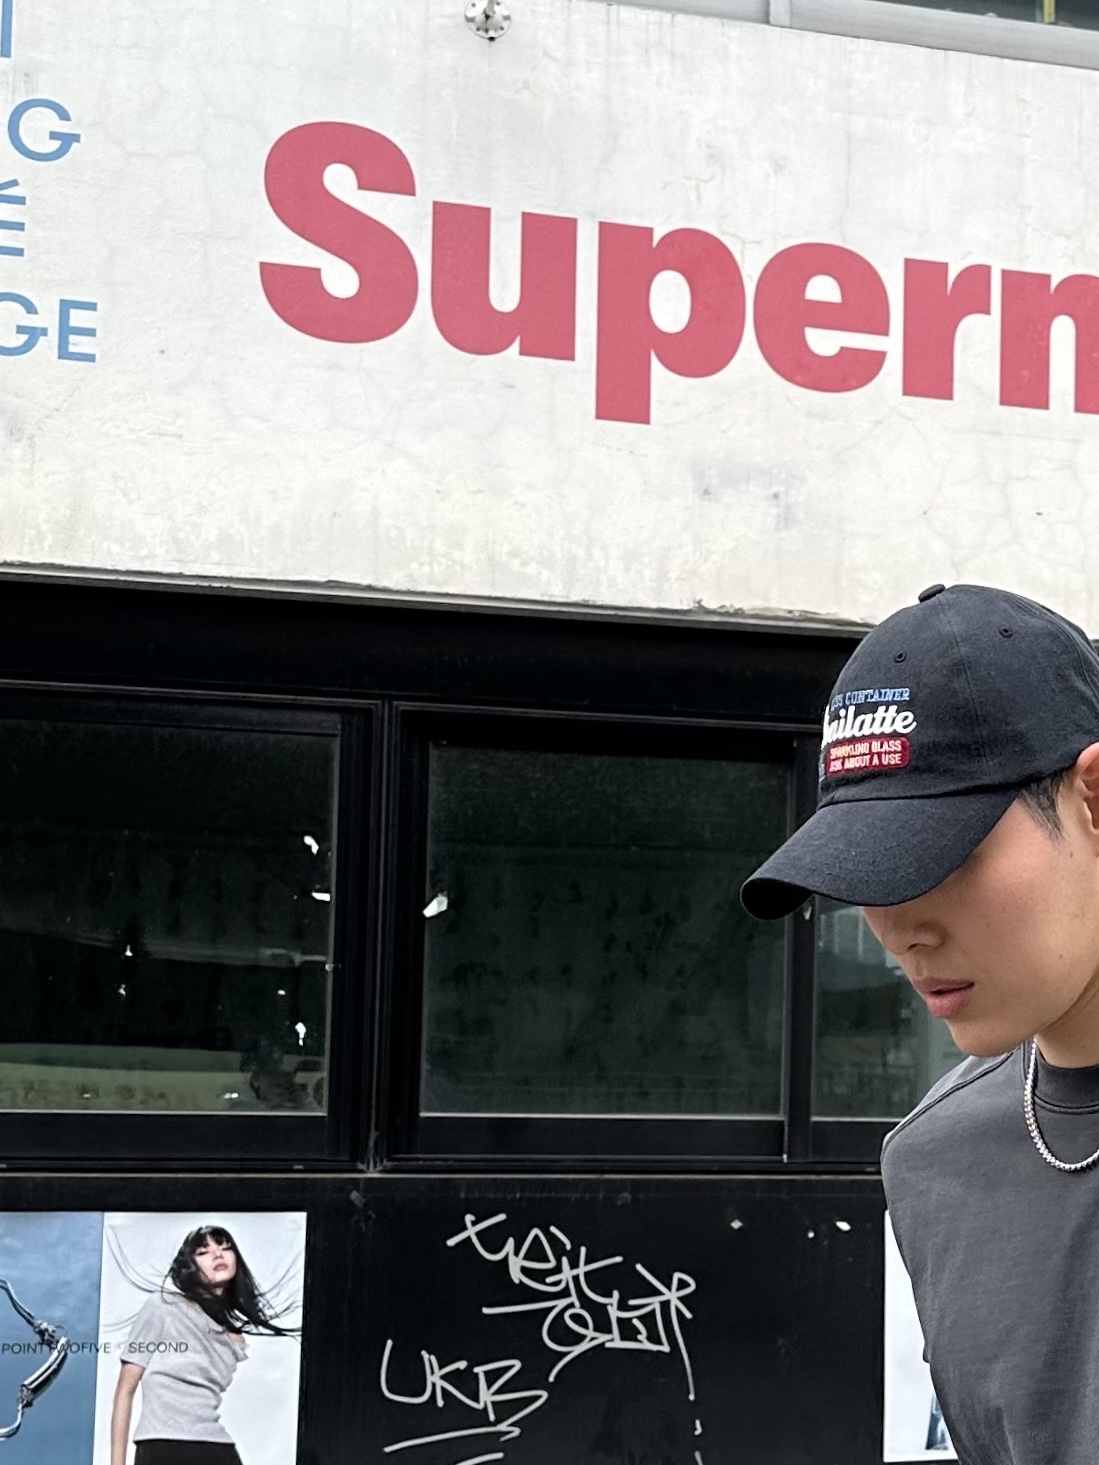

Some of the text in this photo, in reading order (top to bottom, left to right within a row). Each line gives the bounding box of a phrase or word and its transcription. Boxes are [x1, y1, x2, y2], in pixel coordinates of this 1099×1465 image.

[845, 687, 910, 705] CONTAINER
[871, 739, 902, 753] GLASS
[844, 755, 871, 770] ABOUT
[872, 755, 879, 766] A
[881, 753, 902, 765] USE
[128, 1341, 189, 1354] SECOND
